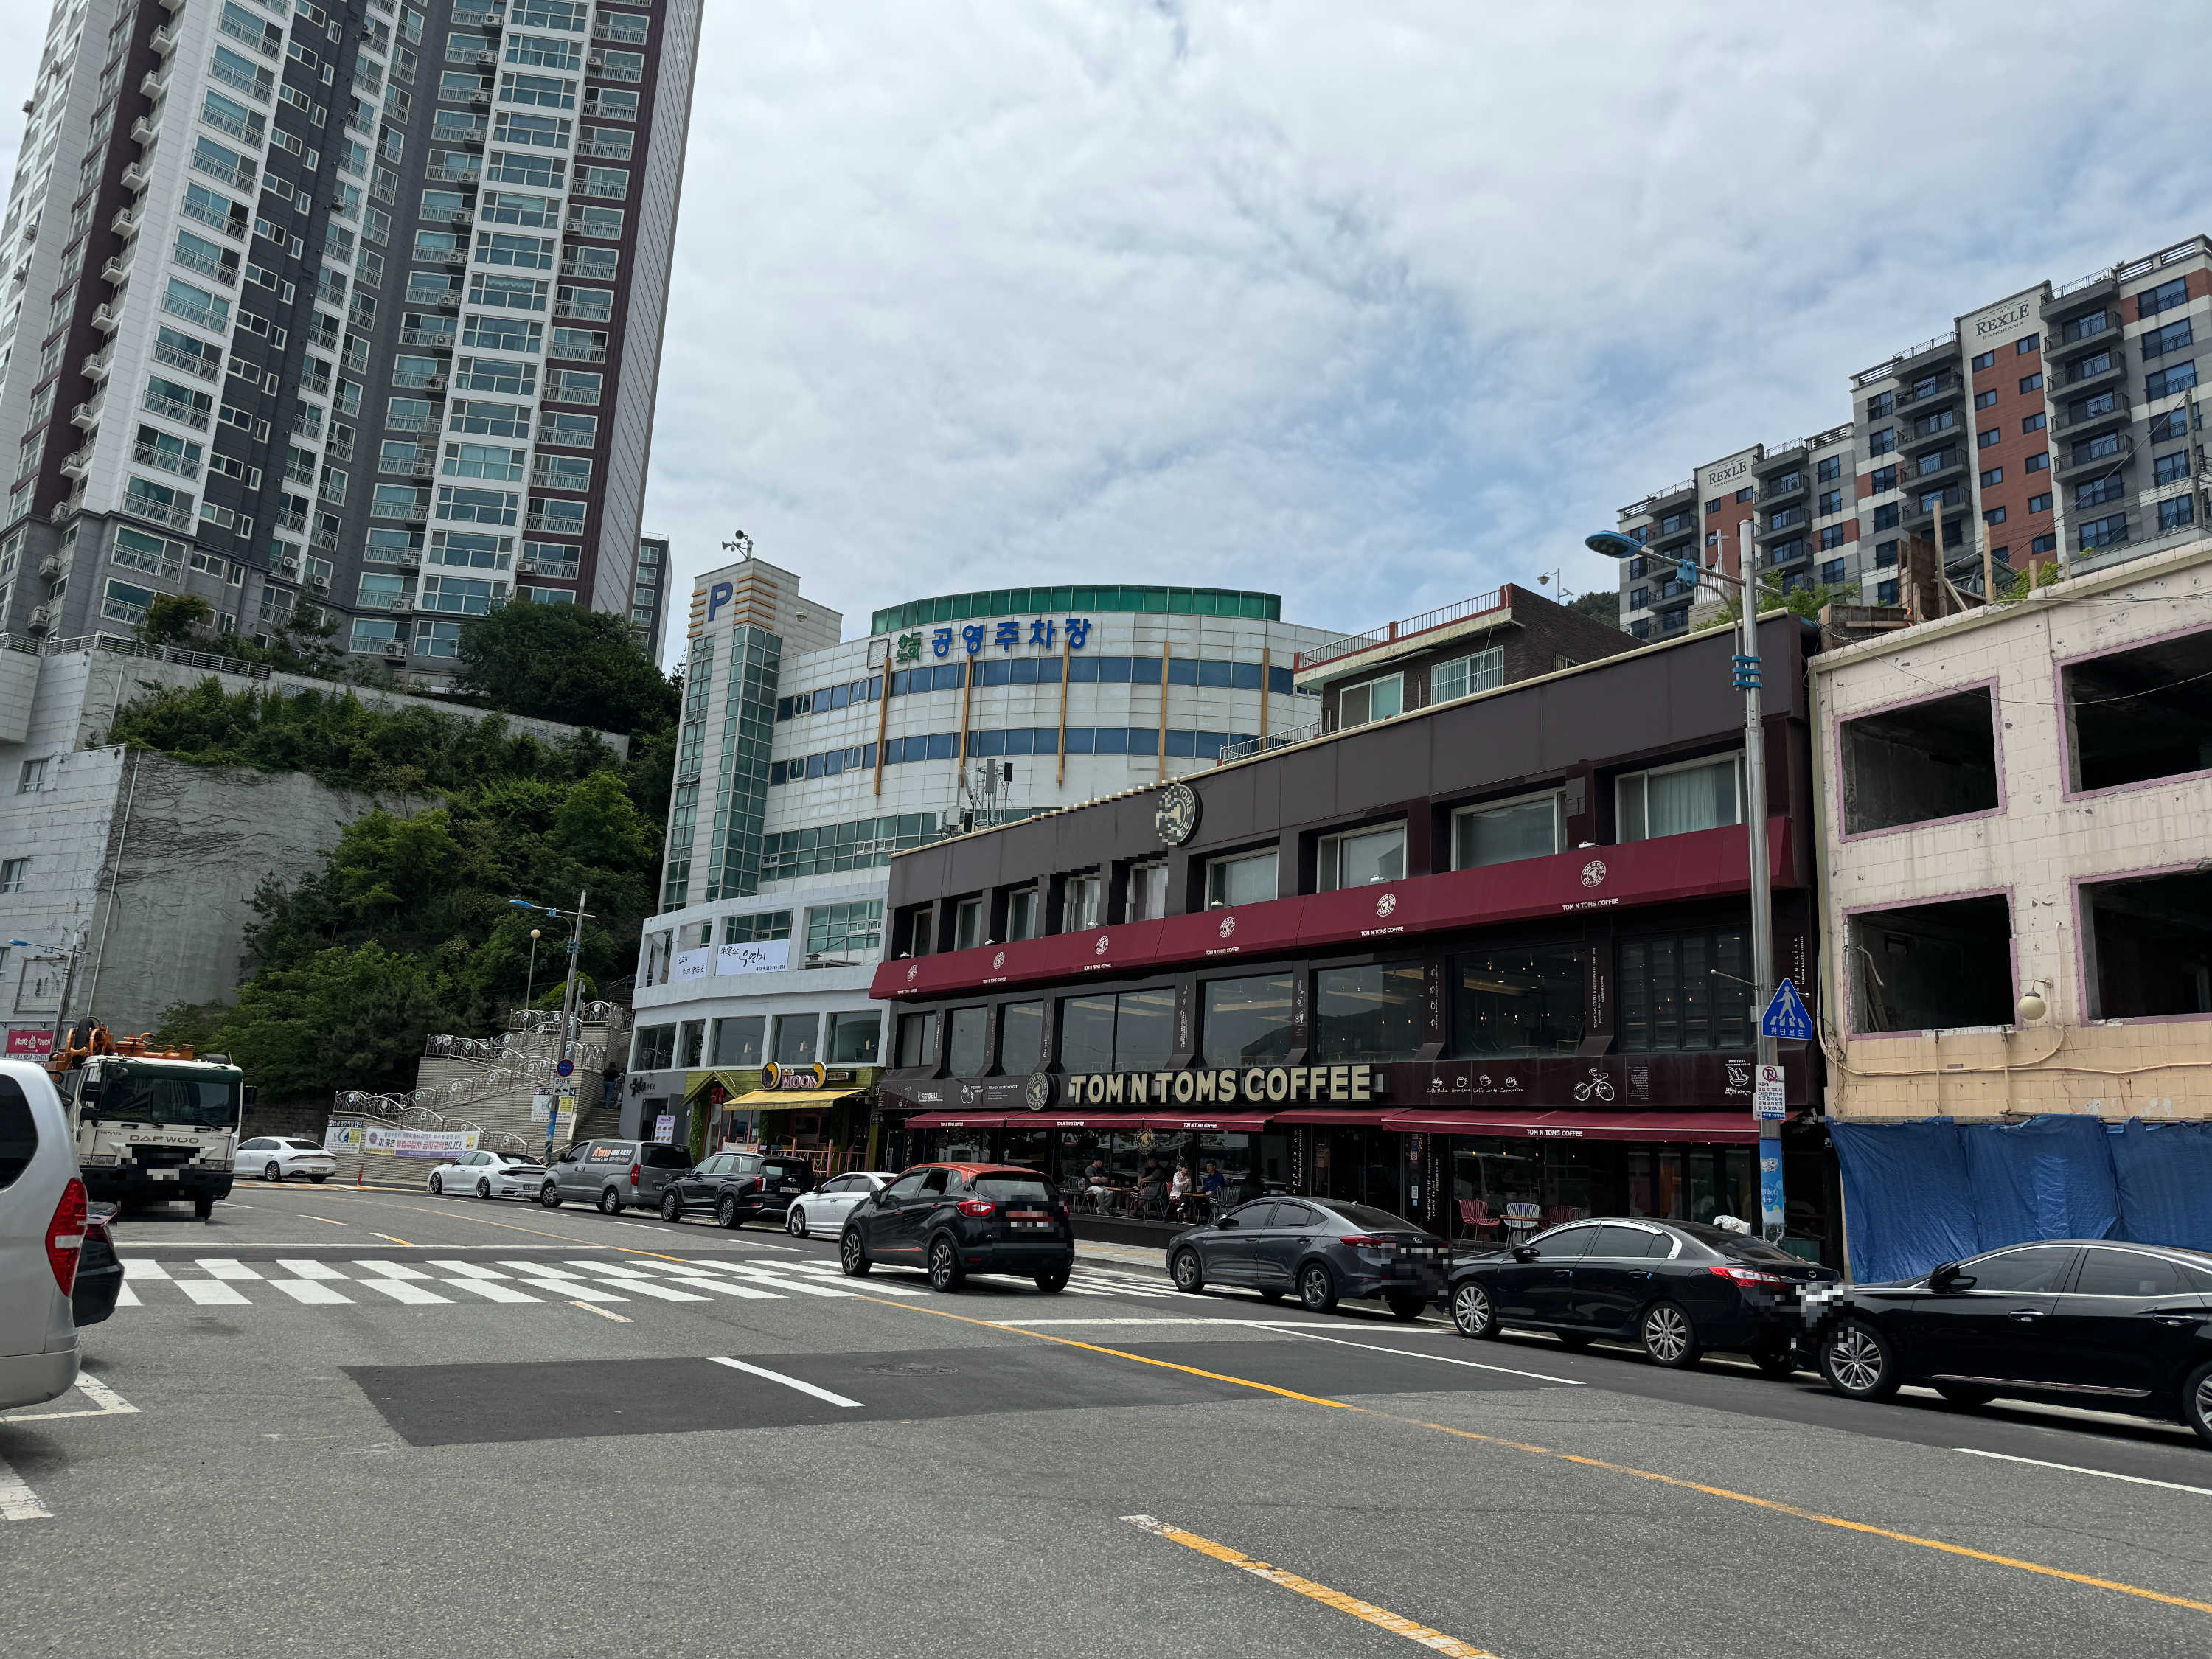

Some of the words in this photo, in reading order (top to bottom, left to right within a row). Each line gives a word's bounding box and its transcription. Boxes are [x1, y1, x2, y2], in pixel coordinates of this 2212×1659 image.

[1975, 304, 2029, 337] REXLE
[1983, 321, 2024, 340] PANORAMA
[1708, 461, 1747, 485] REXLE
[1713, 476, 1742, 489] PANORAMA
[708, 582, 733, 622] P
[932, 619, 1092, 658] 공영주차장
[1792, 936, 1800, 992] appuccino
[1771, 1026, 1804, 1037] 횡단보도
[1028, 1077, 1036, 1089] TOM
[1071, 1074, 1124, 1104] TOM
[1130, 1073, 1147, 1102] N
[1155, 1071, 1237, 1104] TOMS
[1245, 1065, 1371, 1102] COFFEE
[1027, 1093, 1044, 1107] COFFEE
[129, 1135, 200, 1144] DAEWOO
[378, 1138, 384, 1147] 이
[385, 1139, 395, 1147] 곳은
[397, 1140, 422, 1149] 불법주정차
[423, 1141, 462, 1150] 금지구역입니다.
